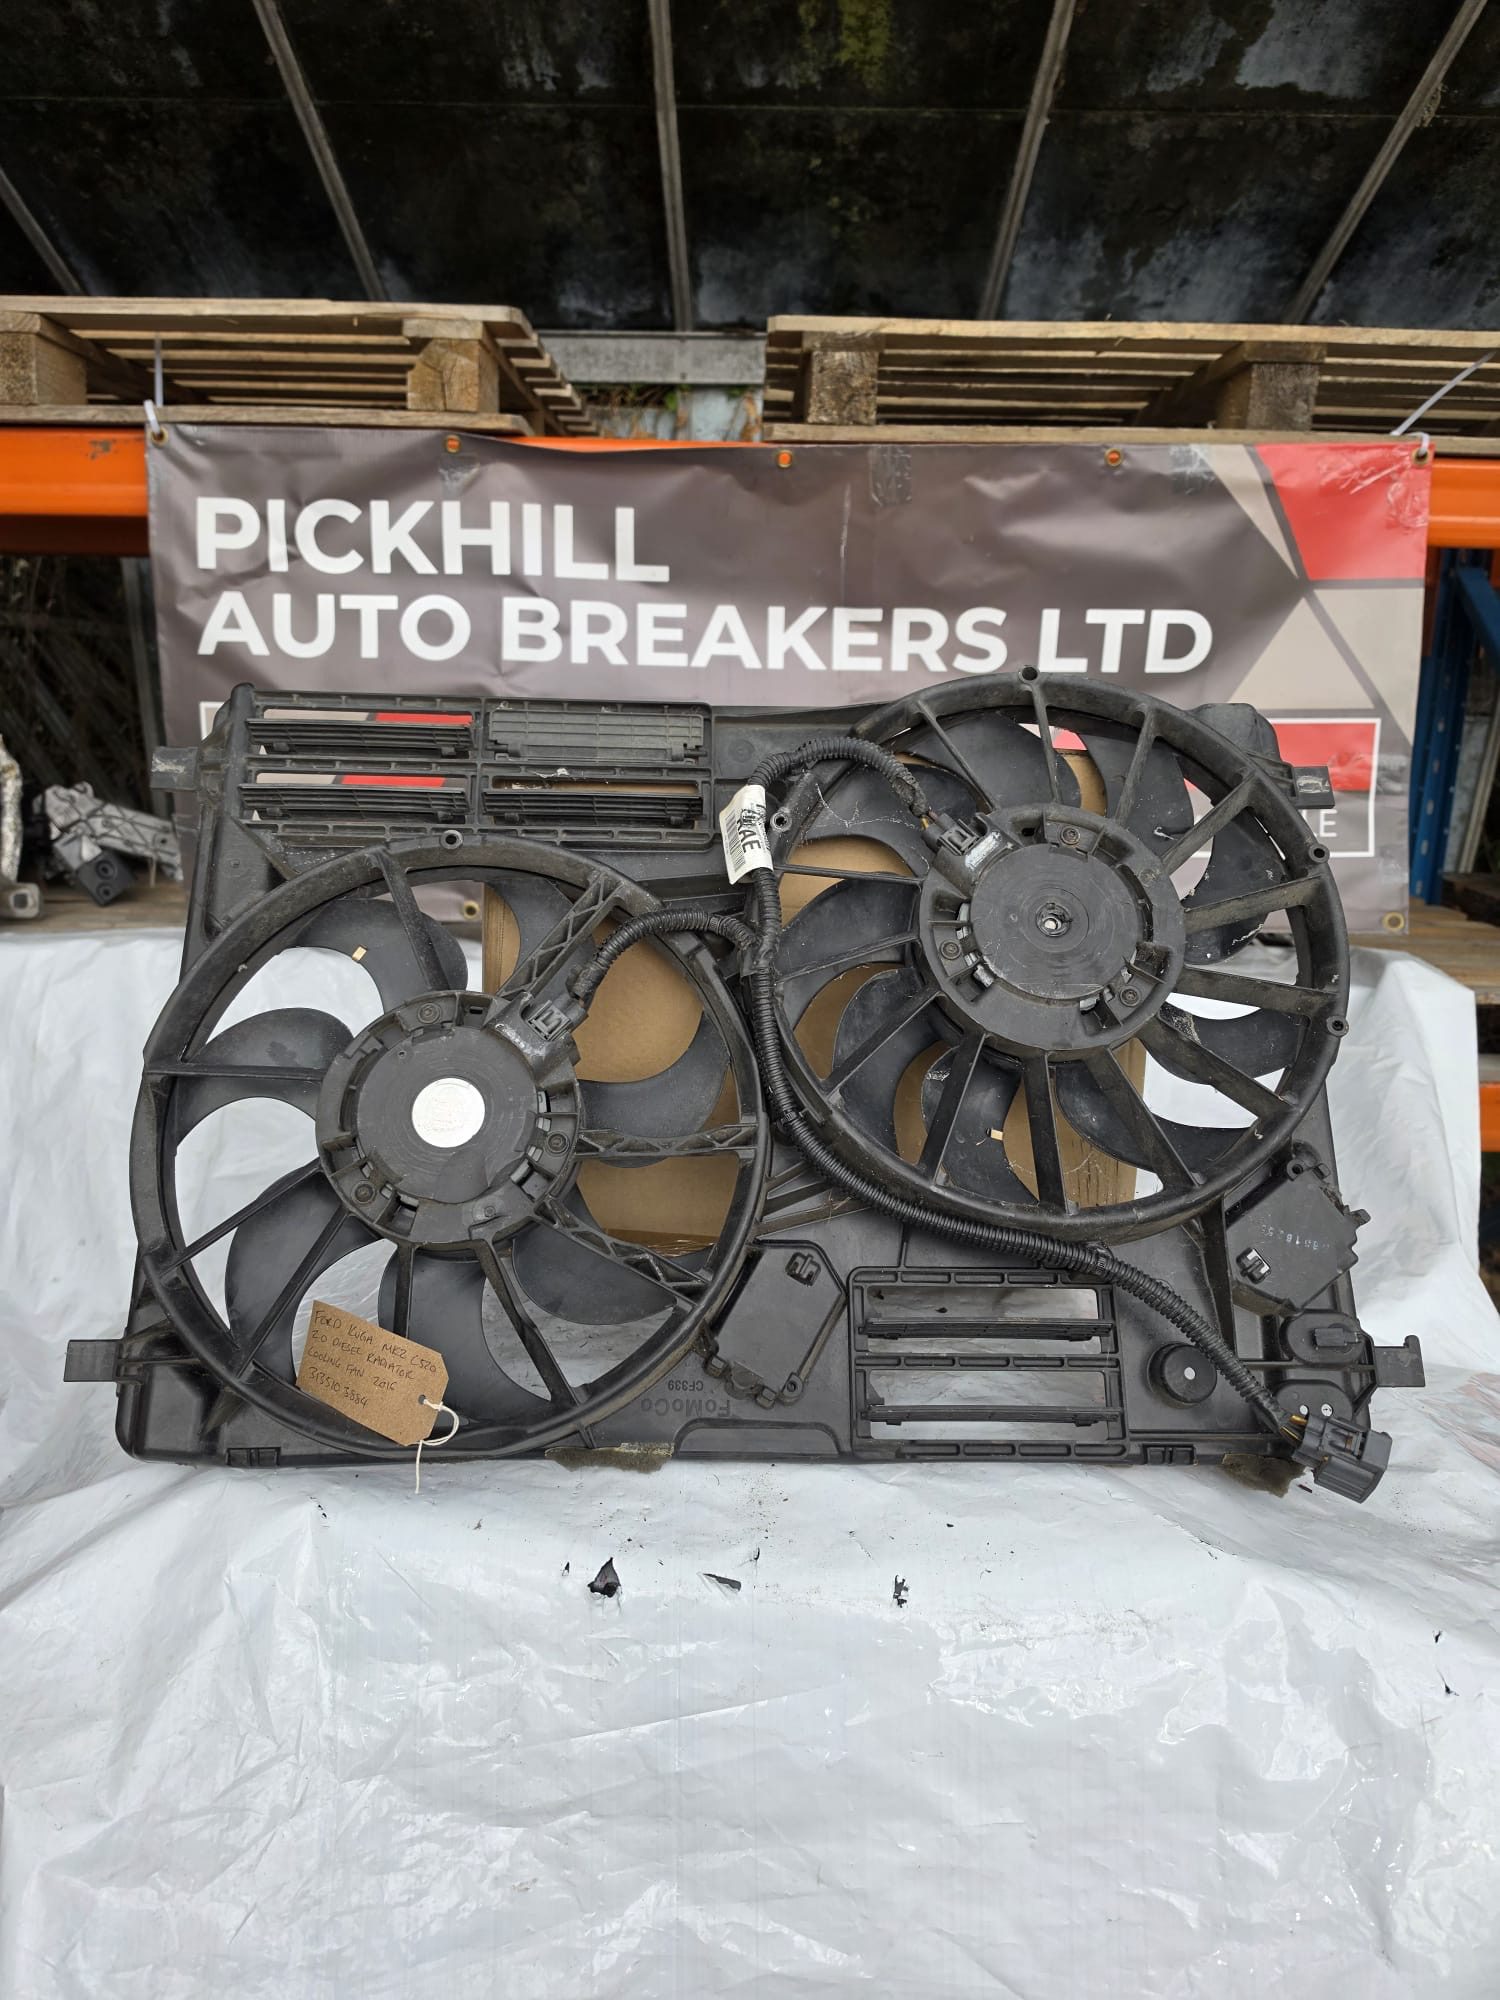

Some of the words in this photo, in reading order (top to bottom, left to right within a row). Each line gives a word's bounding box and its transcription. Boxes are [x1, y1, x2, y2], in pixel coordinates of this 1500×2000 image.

[196, 496, 670, 582] PICKHILL
[198, 591, 472, 662] AUTO
[501, 596, 1008, 674] BREAKERS
[1037, 608, 1212, 673] LTD
[313, 1310, 342, 1329] FORD
[348, 1324, 373, 1345] KUGA
[381, 1343, 407, 1360] MK2
[307, 1347, 341, 1368] COOLING
[345, 1363, 365, 1378] FAN
[332, 1337, 362, 1356] DIESEL
[366, 1352, 415, 1381] RADIATOR
[667, 1379, 704, 1392] CF339
[639, 1398, 731, 1418] FoMoCo
